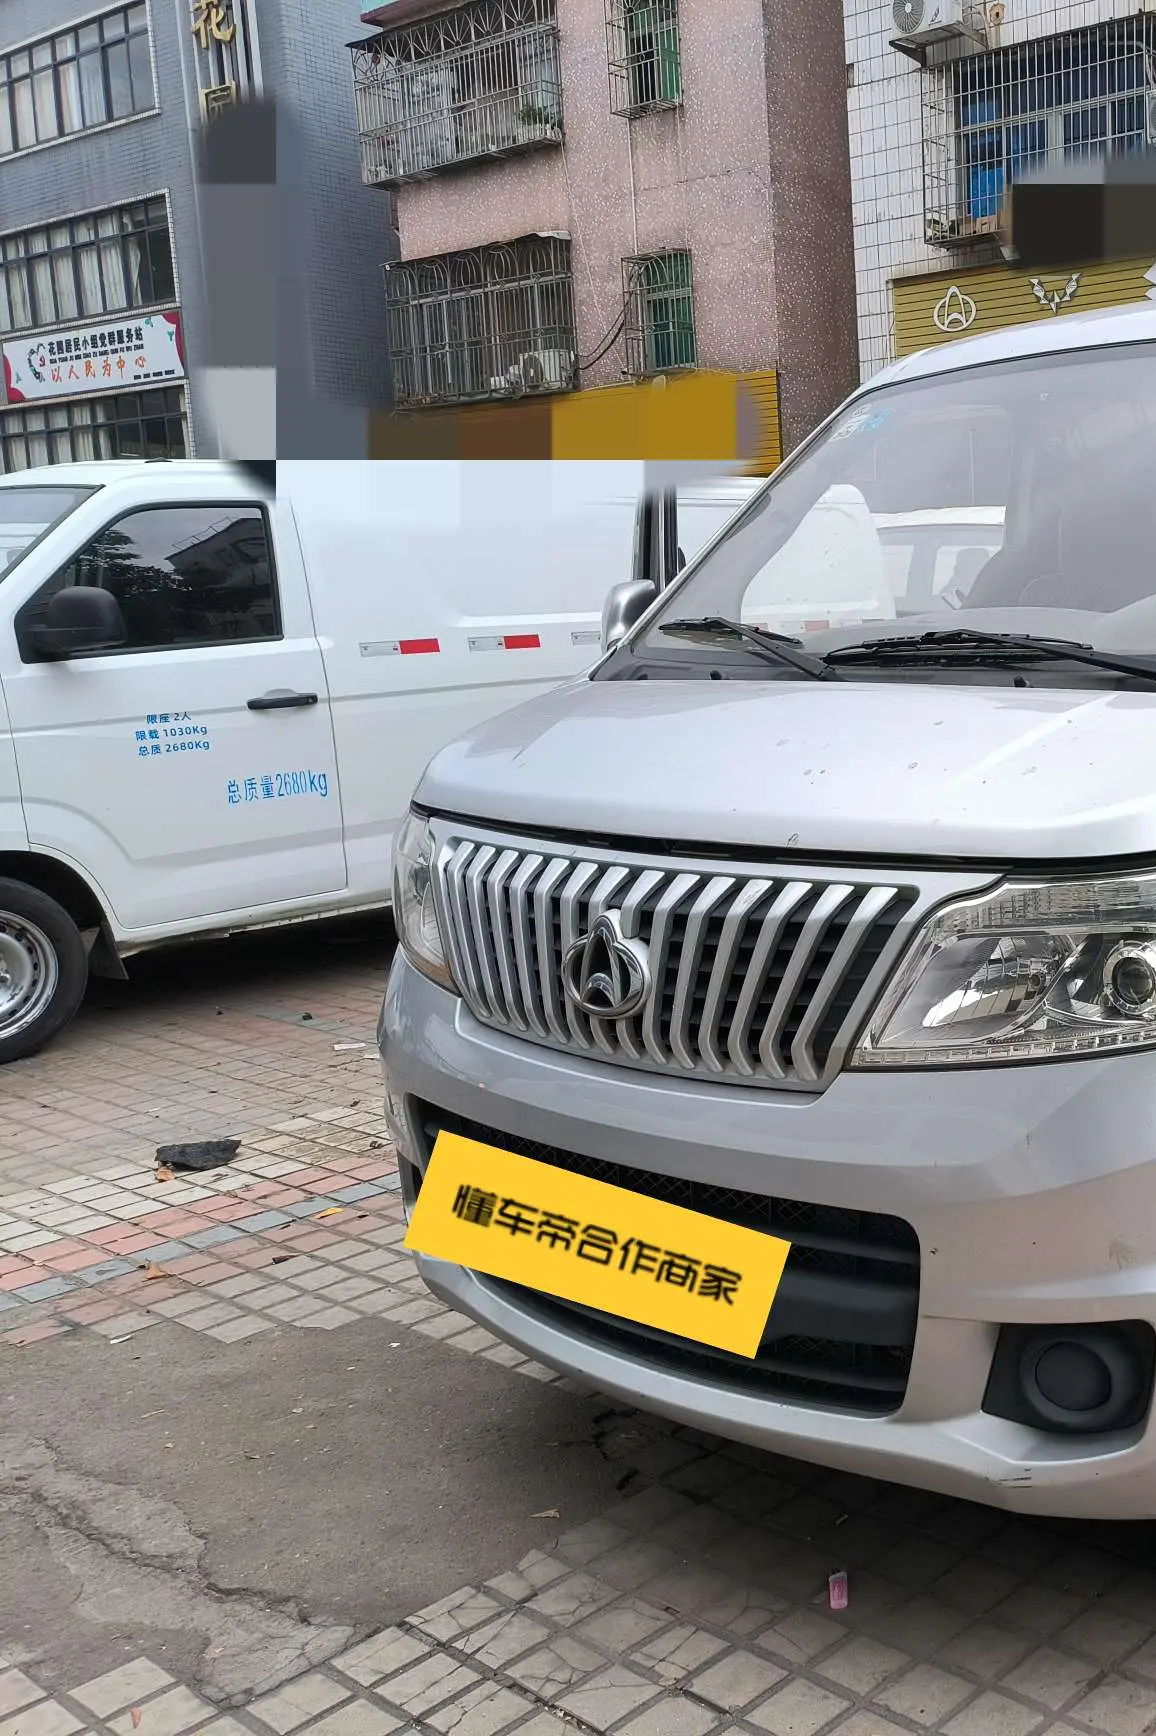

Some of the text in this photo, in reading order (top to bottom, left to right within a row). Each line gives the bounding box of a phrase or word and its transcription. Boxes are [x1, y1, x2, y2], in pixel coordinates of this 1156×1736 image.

[51, 355, 147, 383] 以人民为中心
[146, 711, 191, 724] 限座 2人
[162, 725, 208, 737] 1030Kg
[138, 740, 210, 757] 总质 2680Kg
[227, 769, 328, 804] 总质量2680kg
